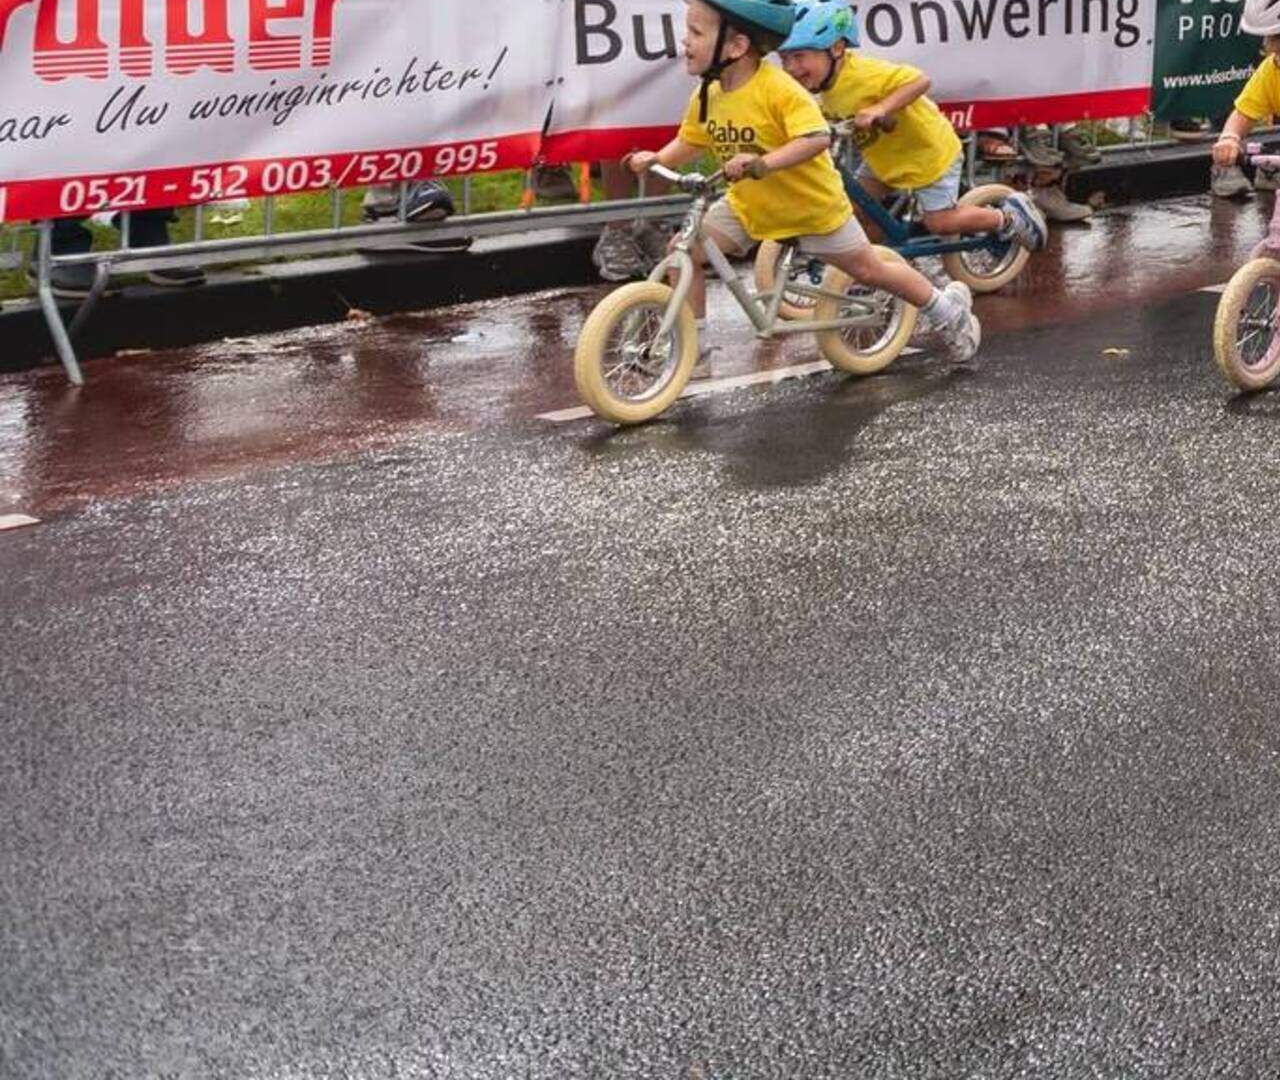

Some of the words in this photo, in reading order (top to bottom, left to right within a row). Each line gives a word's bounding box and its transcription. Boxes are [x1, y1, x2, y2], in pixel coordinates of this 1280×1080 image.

[95, 84, 169, 134] Uw
[189, 46, 509, 127] woninginrichter!
[706, 120, 756, 144] Rabo
[58, 175, 148, 213] 0521
[189, 163, 249, 202] 512
[432, 139, 499, 180] 995
